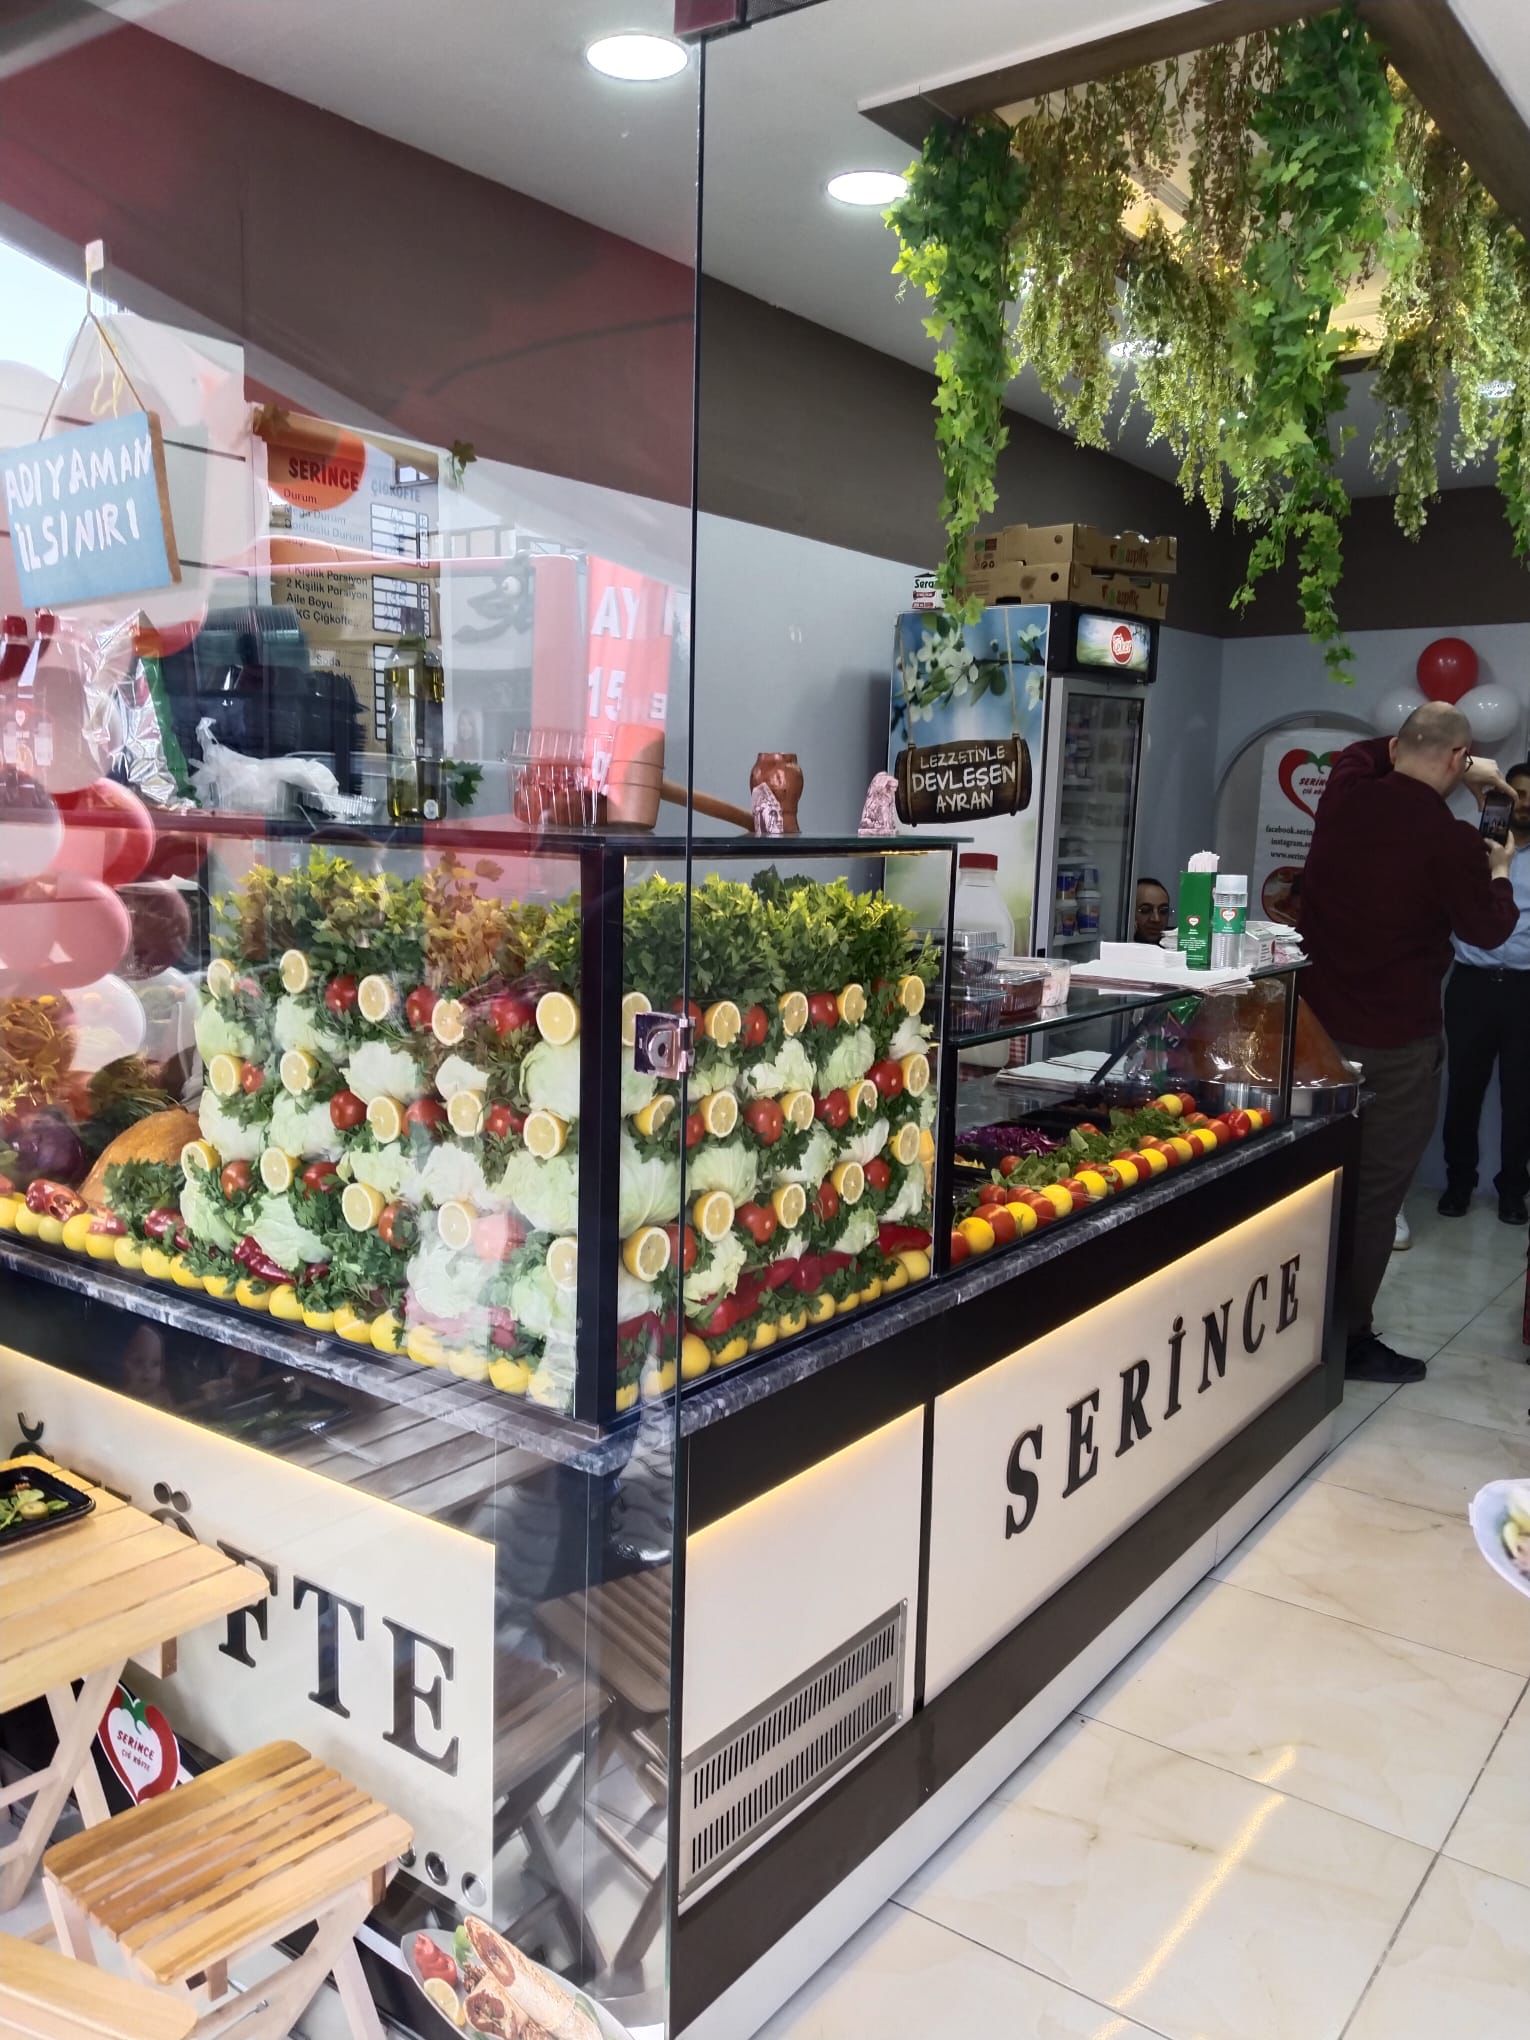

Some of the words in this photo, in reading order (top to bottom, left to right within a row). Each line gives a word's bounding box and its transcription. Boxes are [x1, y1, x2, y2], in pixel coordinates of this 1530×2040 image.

[5, 433, 151, 515] ADIYAMAN
[289, 456, 359, 491] SERİNCE
[286, 578, 292, 588] 2
[294, 580, 325, 594] Kişilik
[920, 745, 1005, 769] LEZZETİYLE
[912, 761, 1016, 793] DEVLEŞEN
[1298, 776, 1326, 787] SERİN
[936, 789, 994, 814] AYRAN
[1265, 824, 1313, 836] facebook.serin
[1005, 1254, 1301, 1540] SERİNCE
[116, 1729, 156, 1762] SERİNCE
